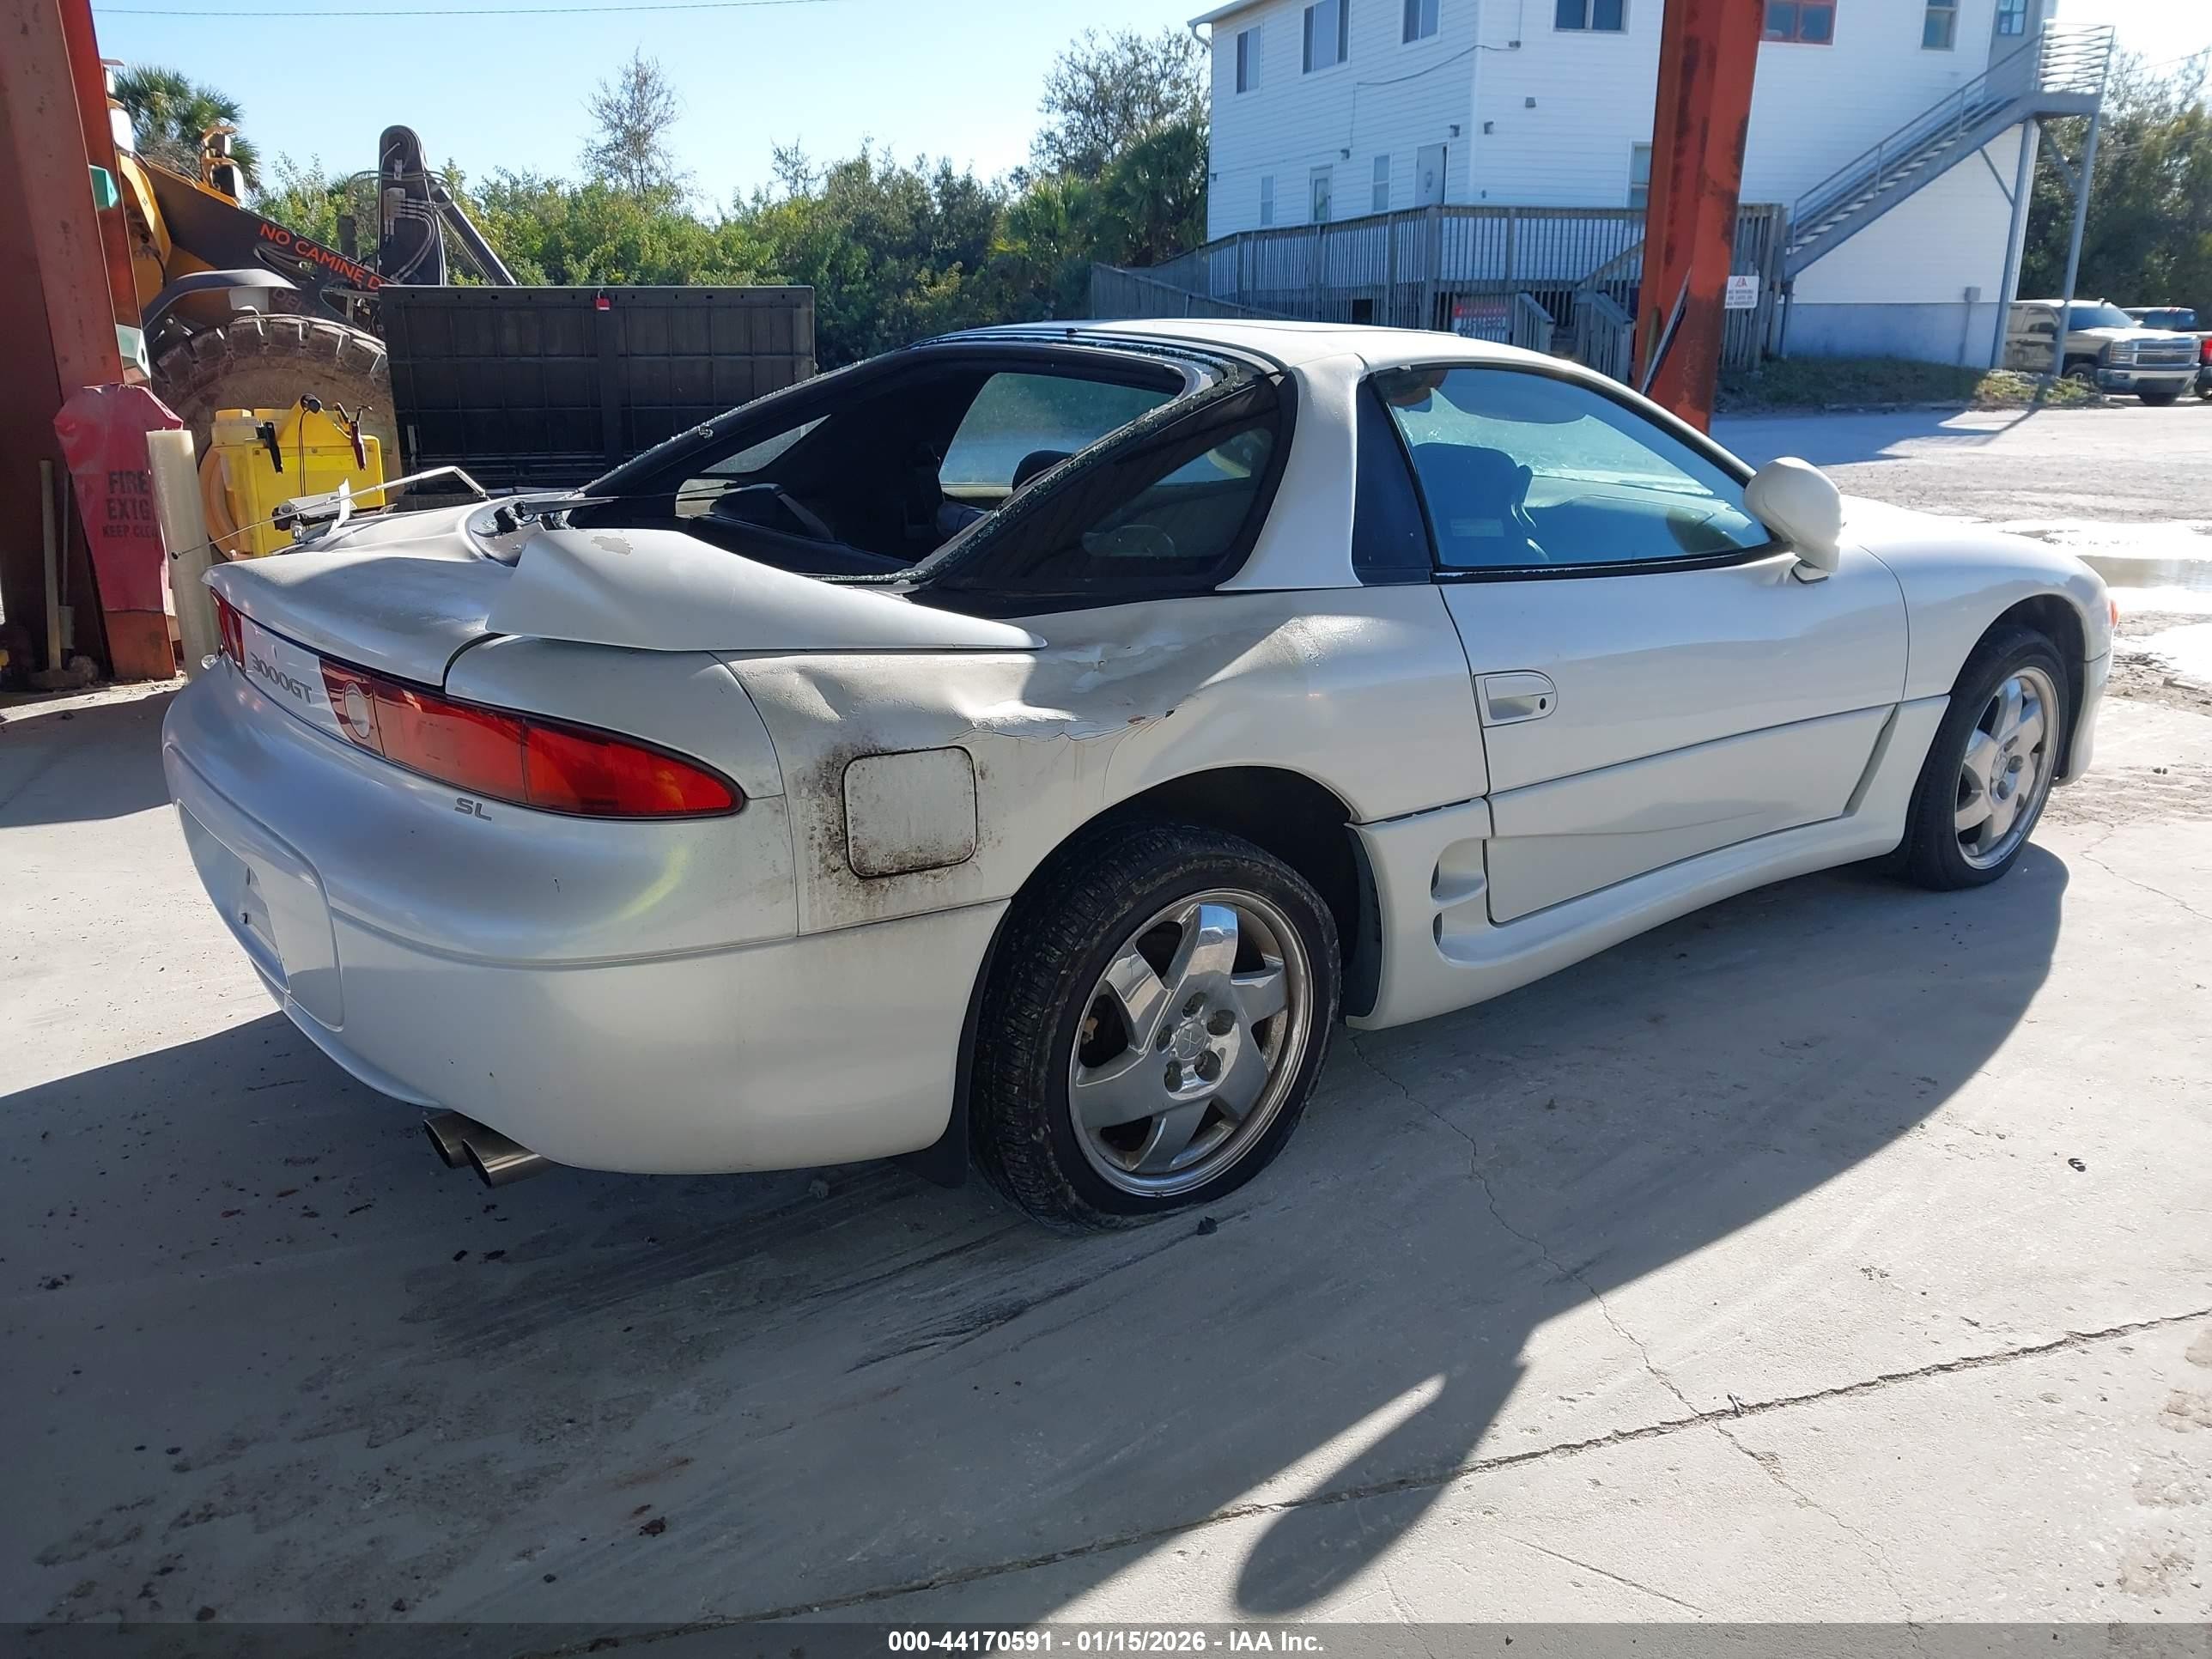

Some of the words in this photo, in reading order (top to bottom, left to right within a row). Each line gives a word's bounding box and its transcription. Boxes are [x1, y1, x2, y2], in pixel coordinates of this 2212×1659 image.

[260, 223, 290, 246] NO
[295, 240, 365, 283] CAMINE
[109, 471, 149, 495] FIRE
[102, 524, 131, 538] KEEP
[249, 651, 313, 703] 3000GT
[453, 797, 493, 822] SL
